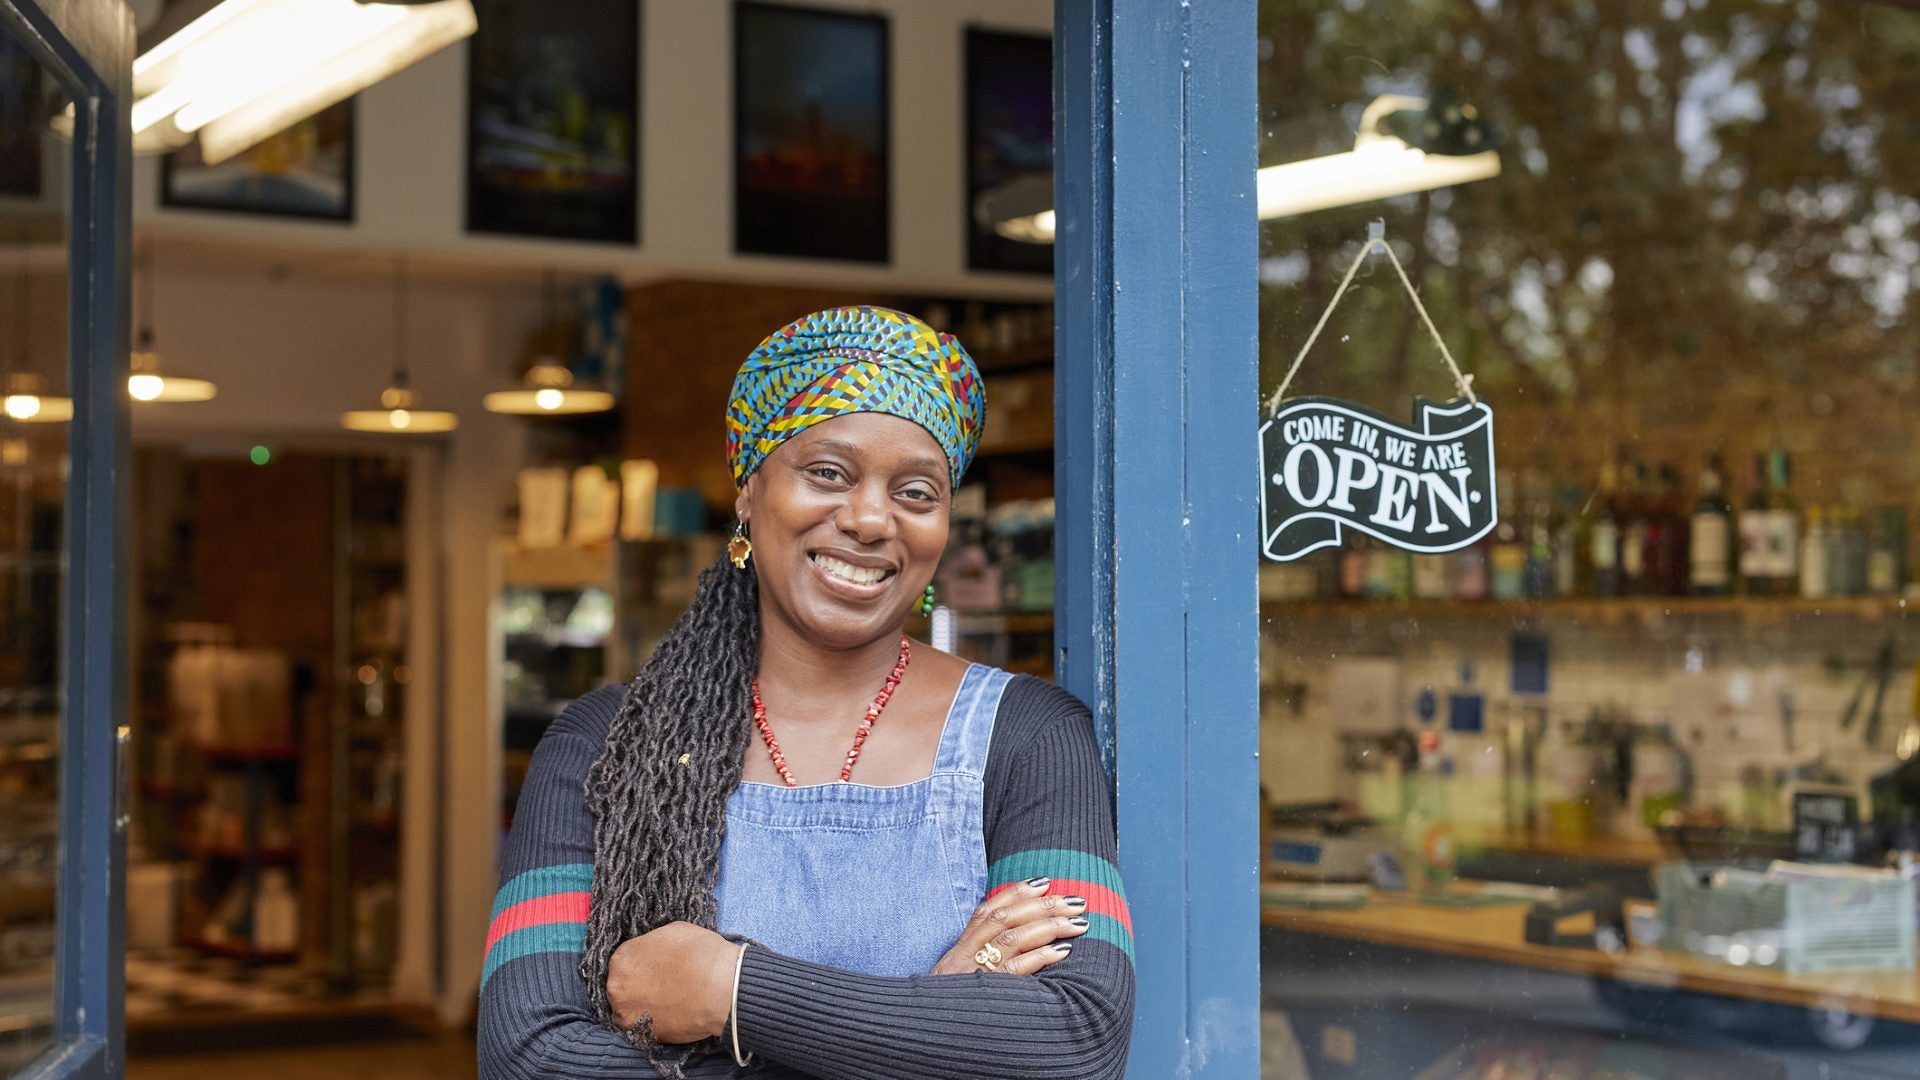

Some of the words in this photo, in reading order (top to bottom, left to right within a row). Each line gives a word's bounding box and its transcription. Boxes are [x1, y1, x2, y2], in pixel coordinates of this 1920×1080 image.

[1283, 415, 1345, 446] COME
[1350, 420, 1380, 459] IN,
[1385, 435, 1417, 468] WE
[1421, 441, 1467, 470] ARE
[1283, 442, 1472, 533] OPEN
